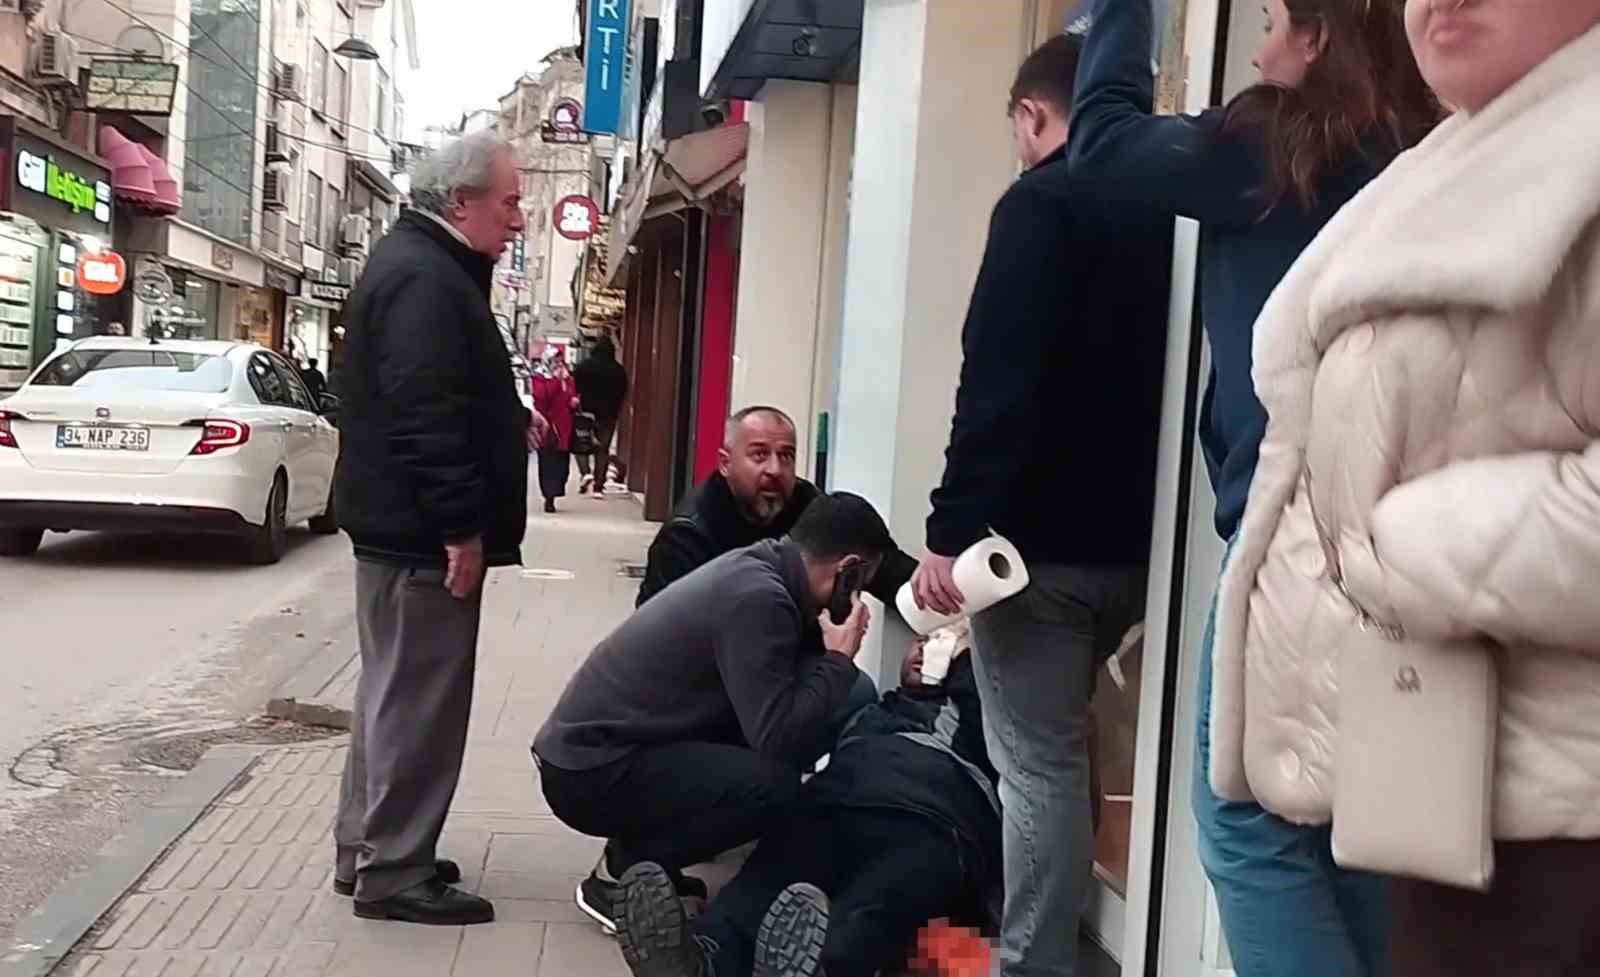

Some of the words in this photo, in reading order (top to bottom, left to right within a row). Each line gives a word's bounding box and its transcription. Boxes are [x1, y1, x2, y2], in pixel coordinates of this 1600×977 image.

[64, 428, 82, 442] 34
[87, 429, 114, 444] NAP
[120, 431, 145, 445] 236
